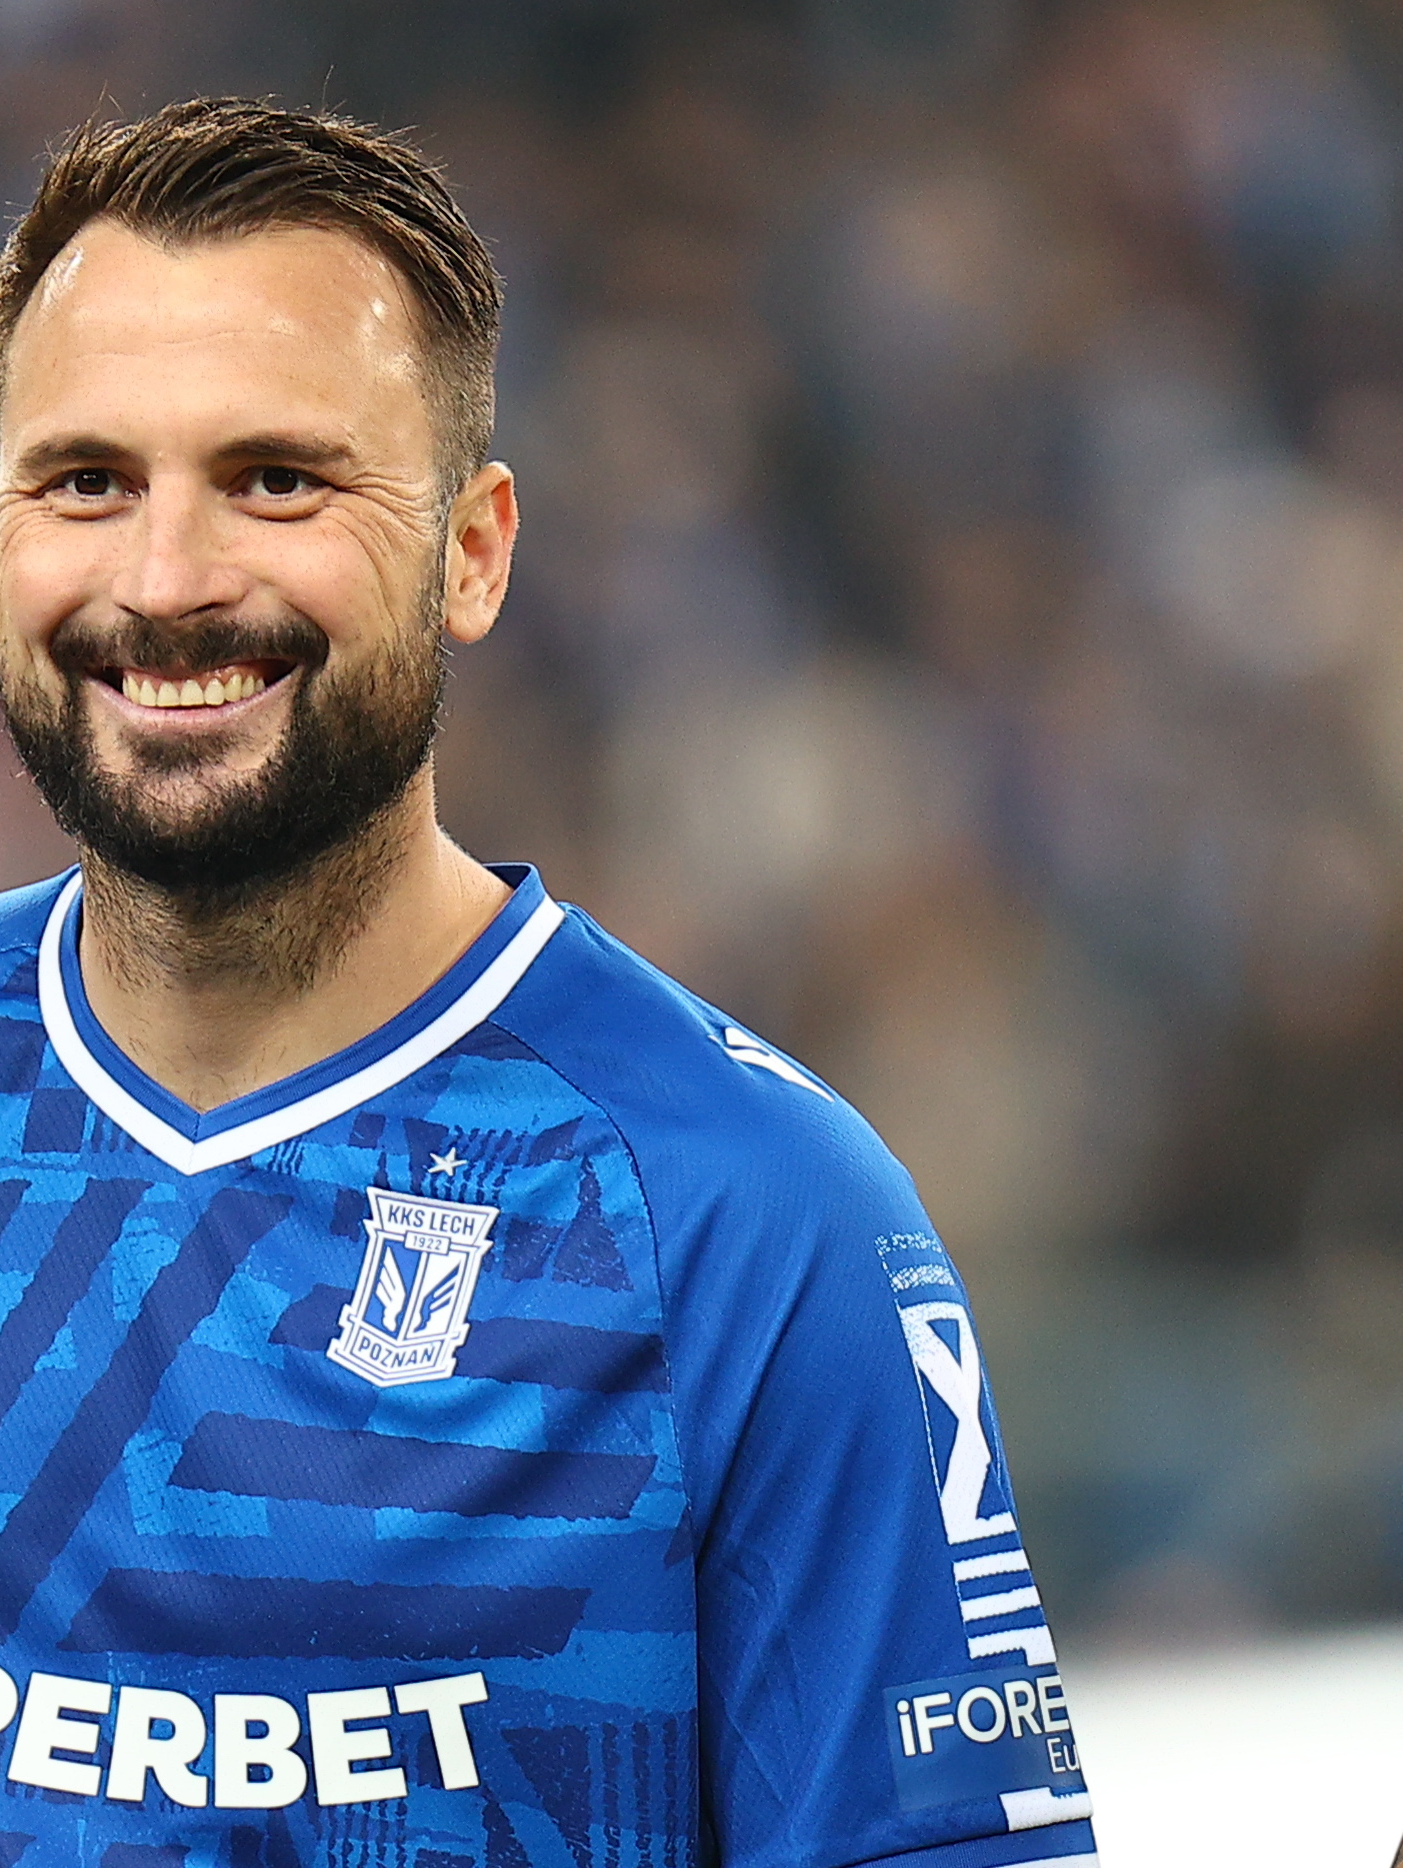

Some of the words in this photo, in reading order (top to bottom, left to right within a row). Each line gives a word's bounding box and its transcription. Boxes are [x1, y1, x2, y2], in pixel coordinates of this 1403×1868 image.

[388, 1204, 425, 1228] KKS
[429, 1211, 475, 1236] LECH
[412, 1235, 442, 1251] 1922
